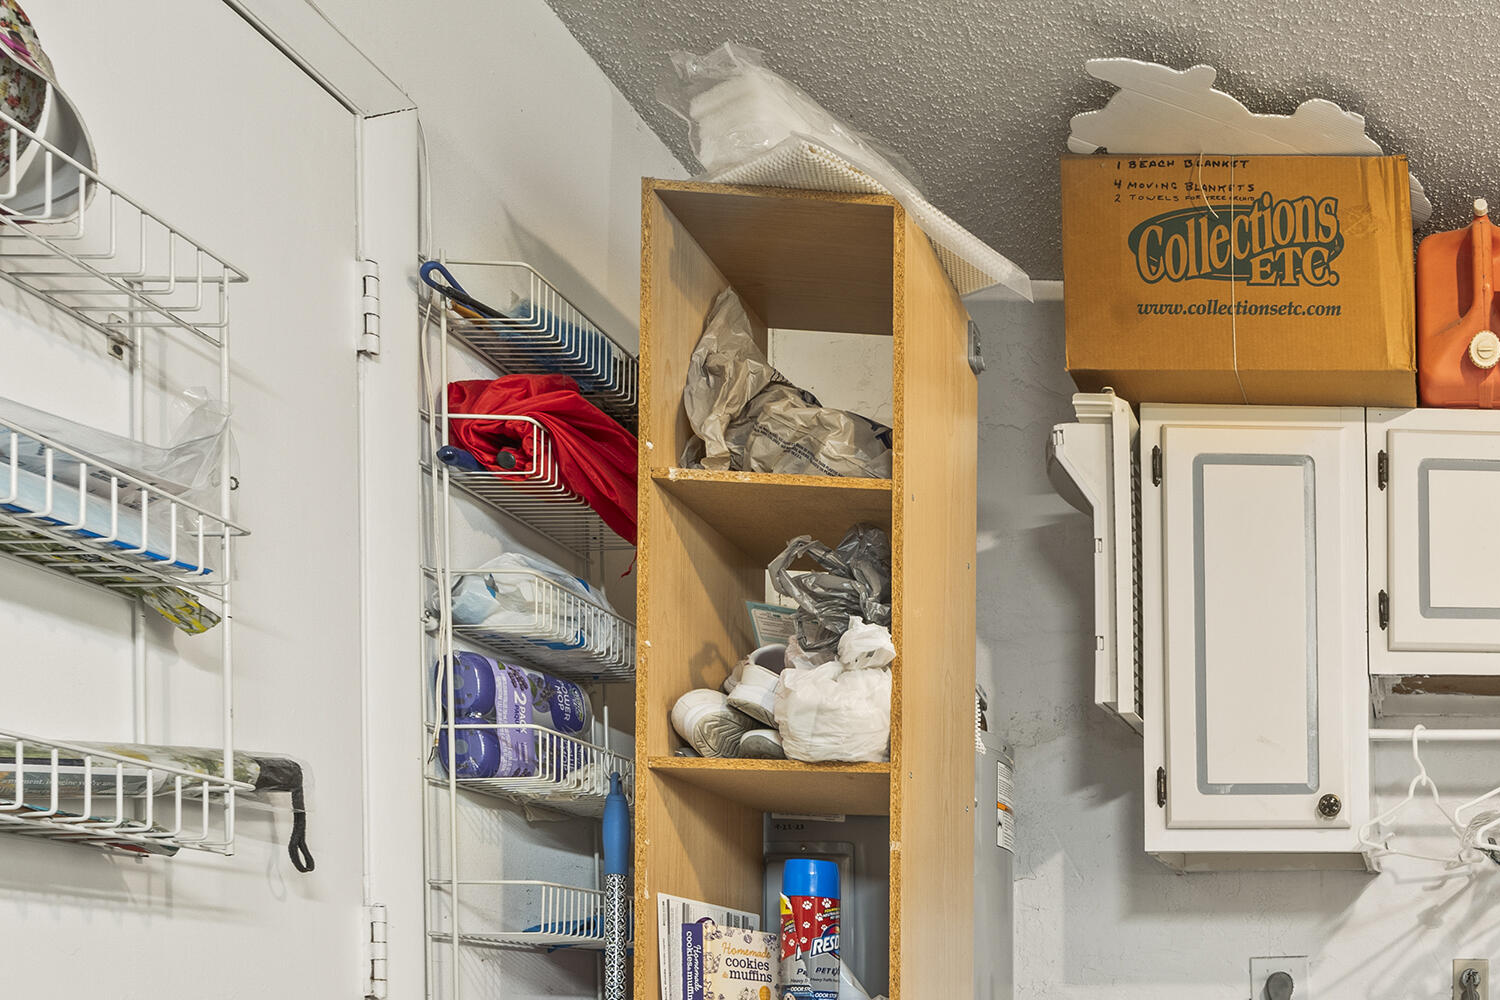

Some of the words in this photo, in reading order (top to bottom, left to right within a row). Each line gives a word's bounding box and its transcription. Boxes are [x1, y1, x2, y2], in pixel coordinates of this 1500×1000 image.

[1128, 159, 1175, 169] BEACH
[1184, 159, 1249, 169] BLANKET
[1113, 179, 1122, 190] 4
[1127, 182, 1178, 190] MOVING
[1185, 181, 1255, 191] BLANKETS
[1130, 194, 1180, 202] TOWELS
[1136, 191, 1340, 285] Collections
[1247, 245, 1340, 287] ETC.
[1137, 299, 1342, 317] www.collectionsetc.com
[554, 684, 566, 712] MOP
[555, 679, 572, 721] POWER
[686, 930, 694, 966] cookies
[721, 941, 772, 959] Homemade
[693, 944, 703, 992] Homemade
[725, 956, 770, 972] cookies
[815, 966, 832, 975] PET
[729, 968, 773, 983] muffins
